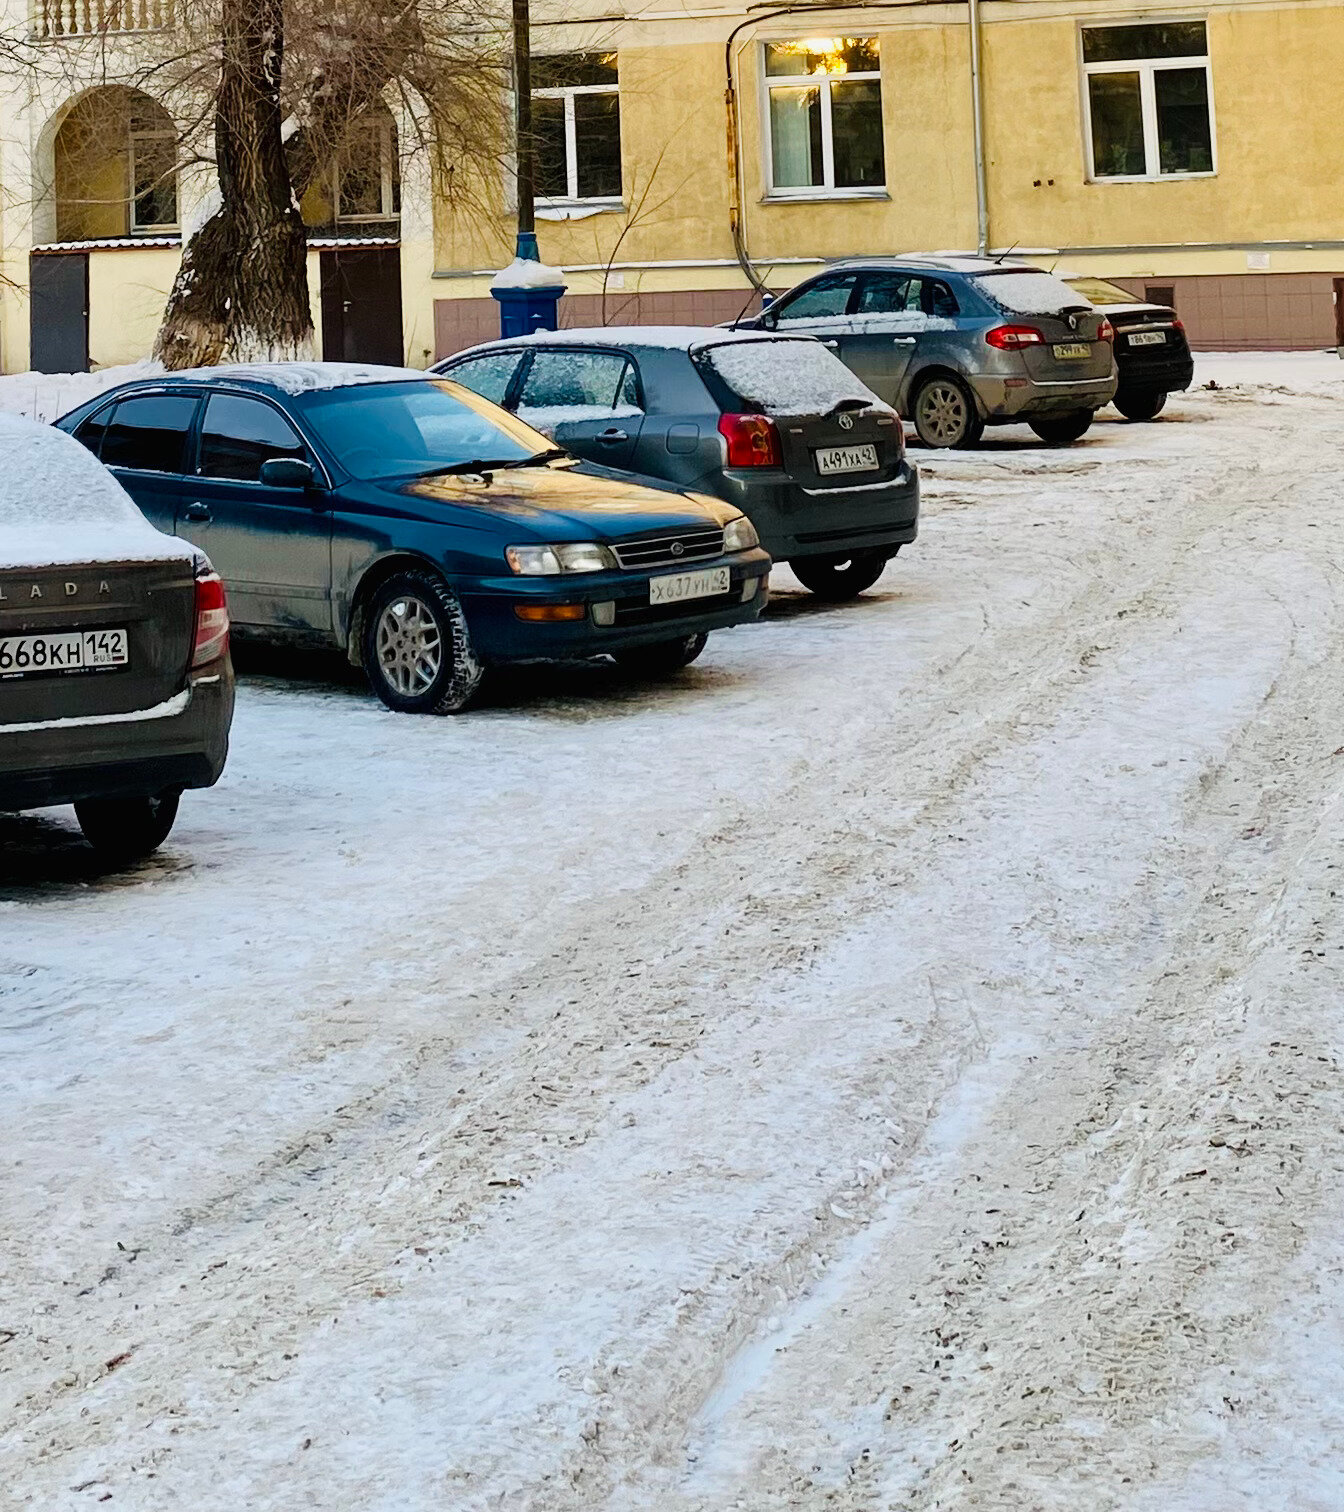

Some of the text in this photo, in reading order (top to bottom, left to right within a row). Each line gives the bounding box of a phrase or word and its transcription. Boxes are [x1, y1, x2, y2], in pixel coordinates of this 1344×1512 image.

[823, 451, 862, 469] А491ХА
[85, 632, 123, 655] 142
[93, 654, 112, 663] RUS
